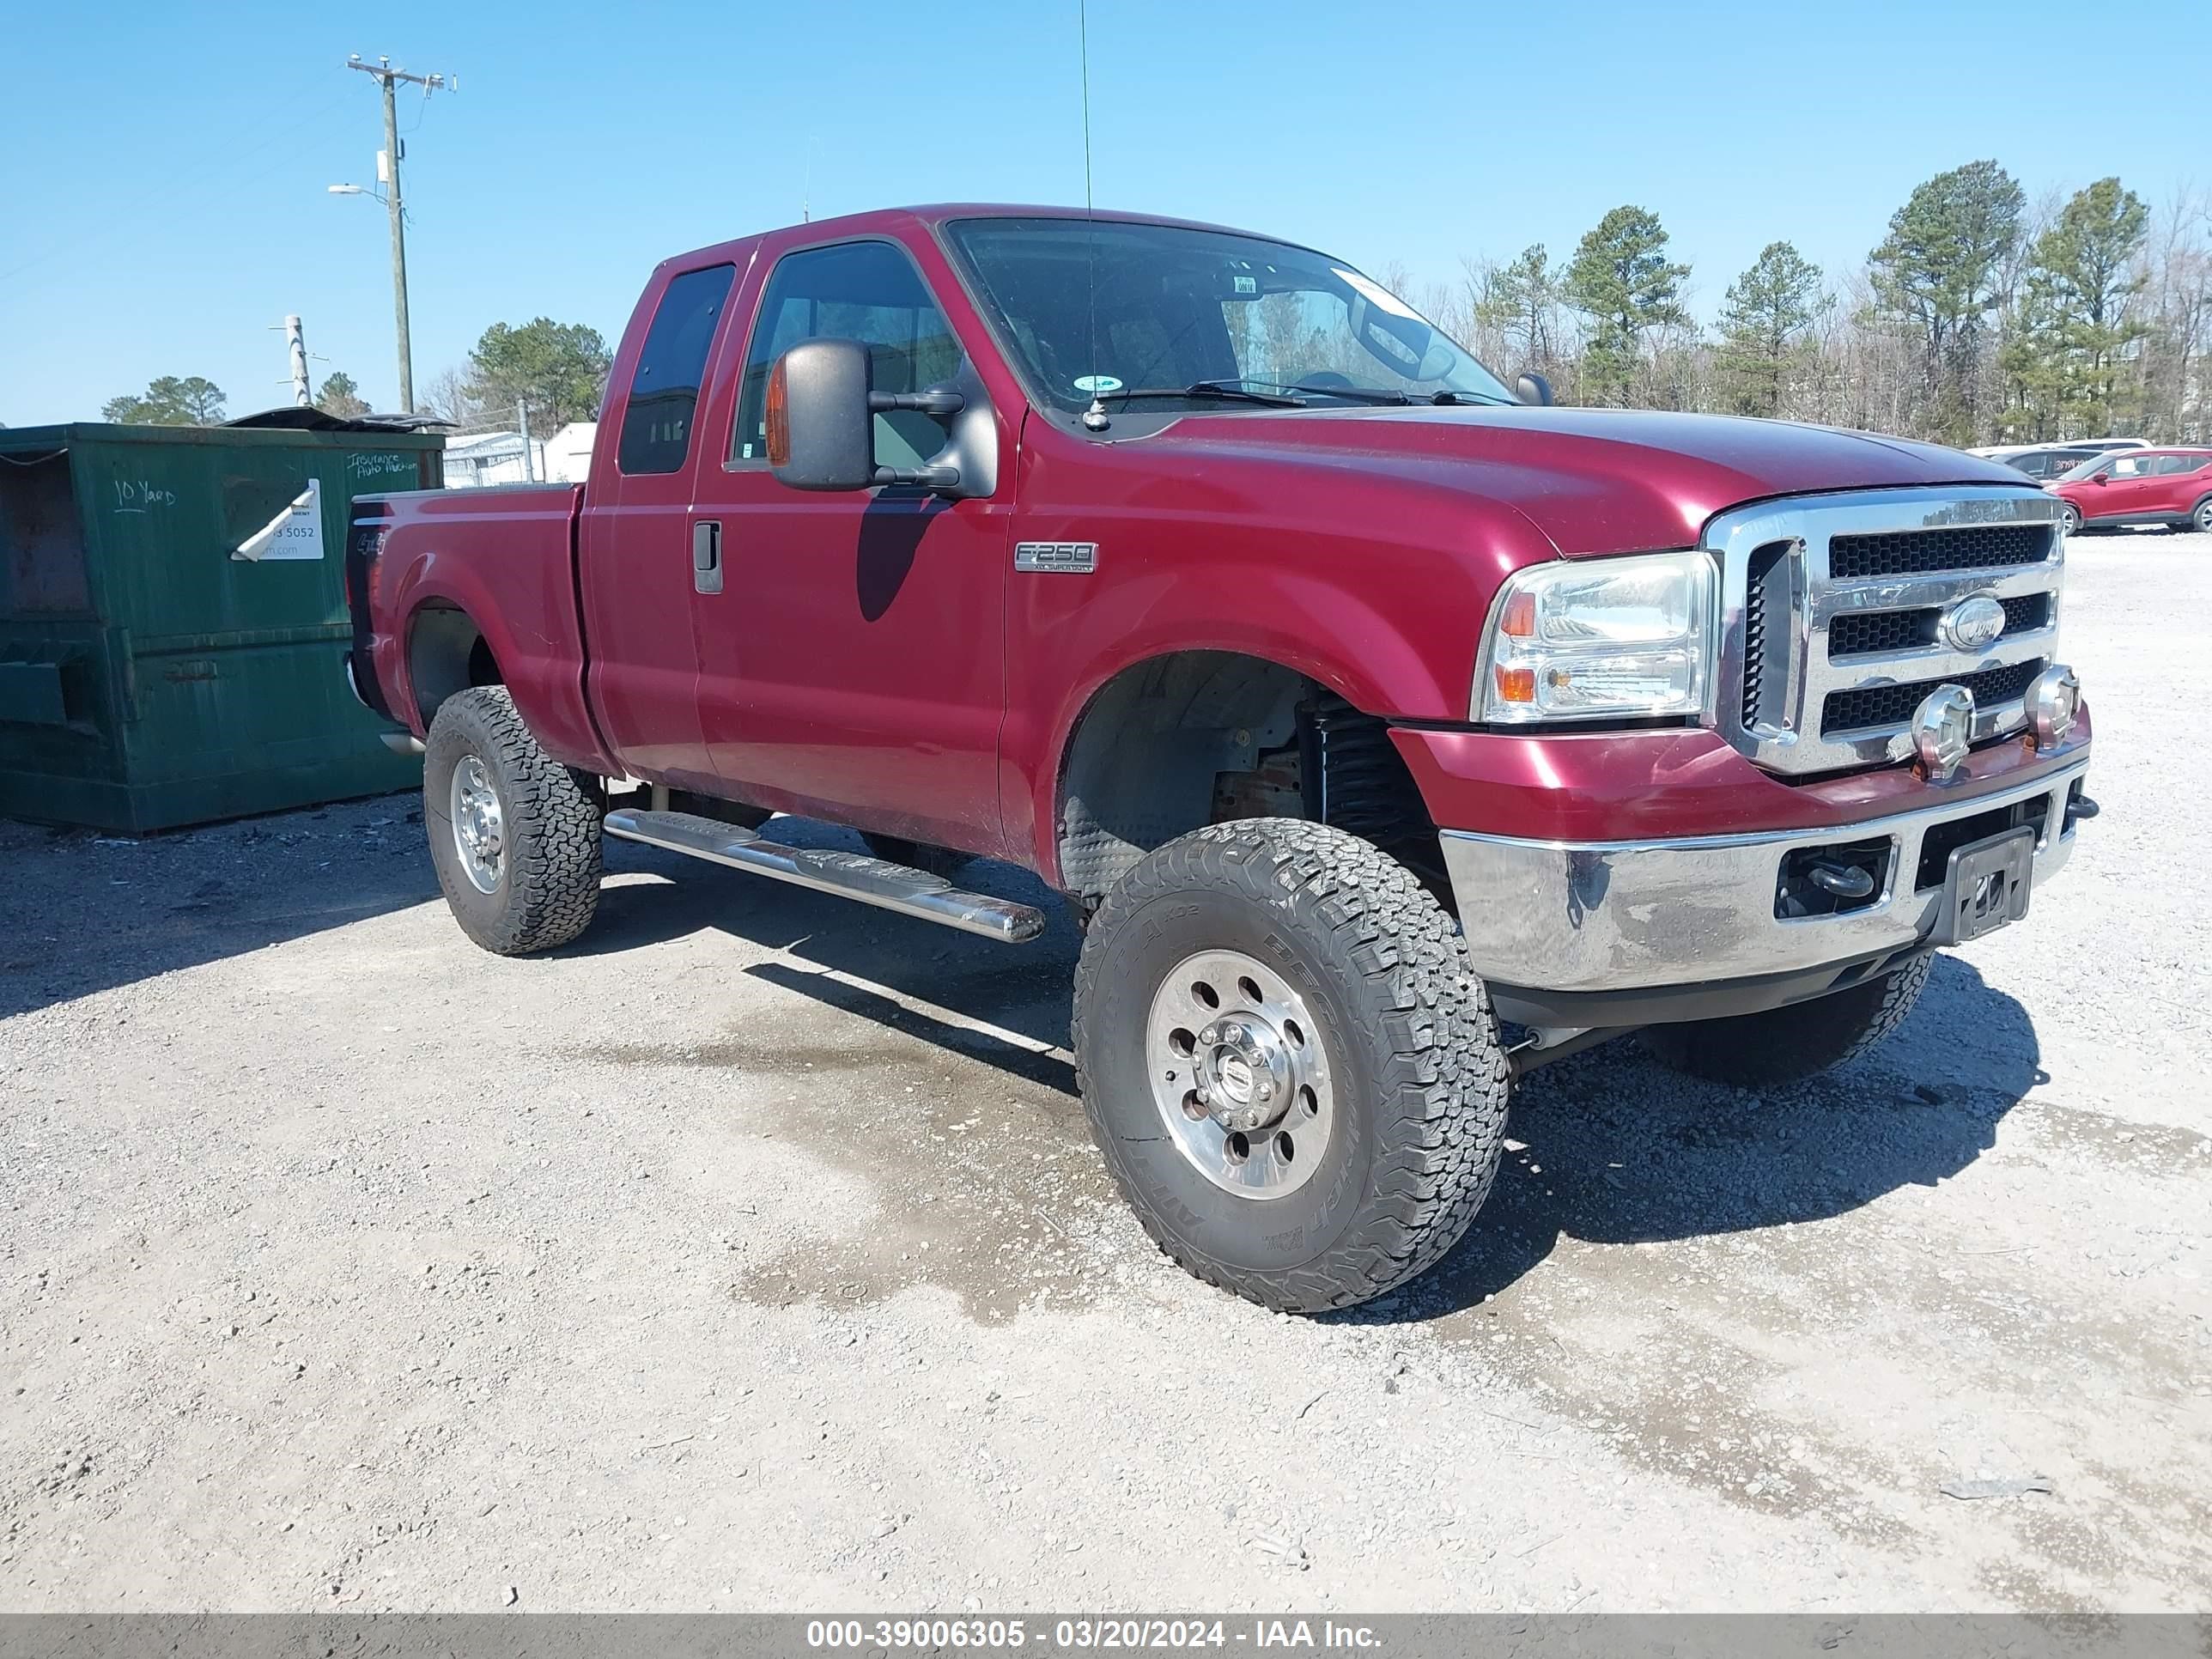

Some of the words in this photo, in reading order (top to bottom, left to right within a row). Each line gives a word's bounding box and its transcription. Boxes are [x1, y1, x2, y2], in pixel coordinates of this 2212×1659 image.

[357, 465, 381, 479] Auto
[114, 481, 135, 507] 10
[287, 527, 314, 538] 5052
